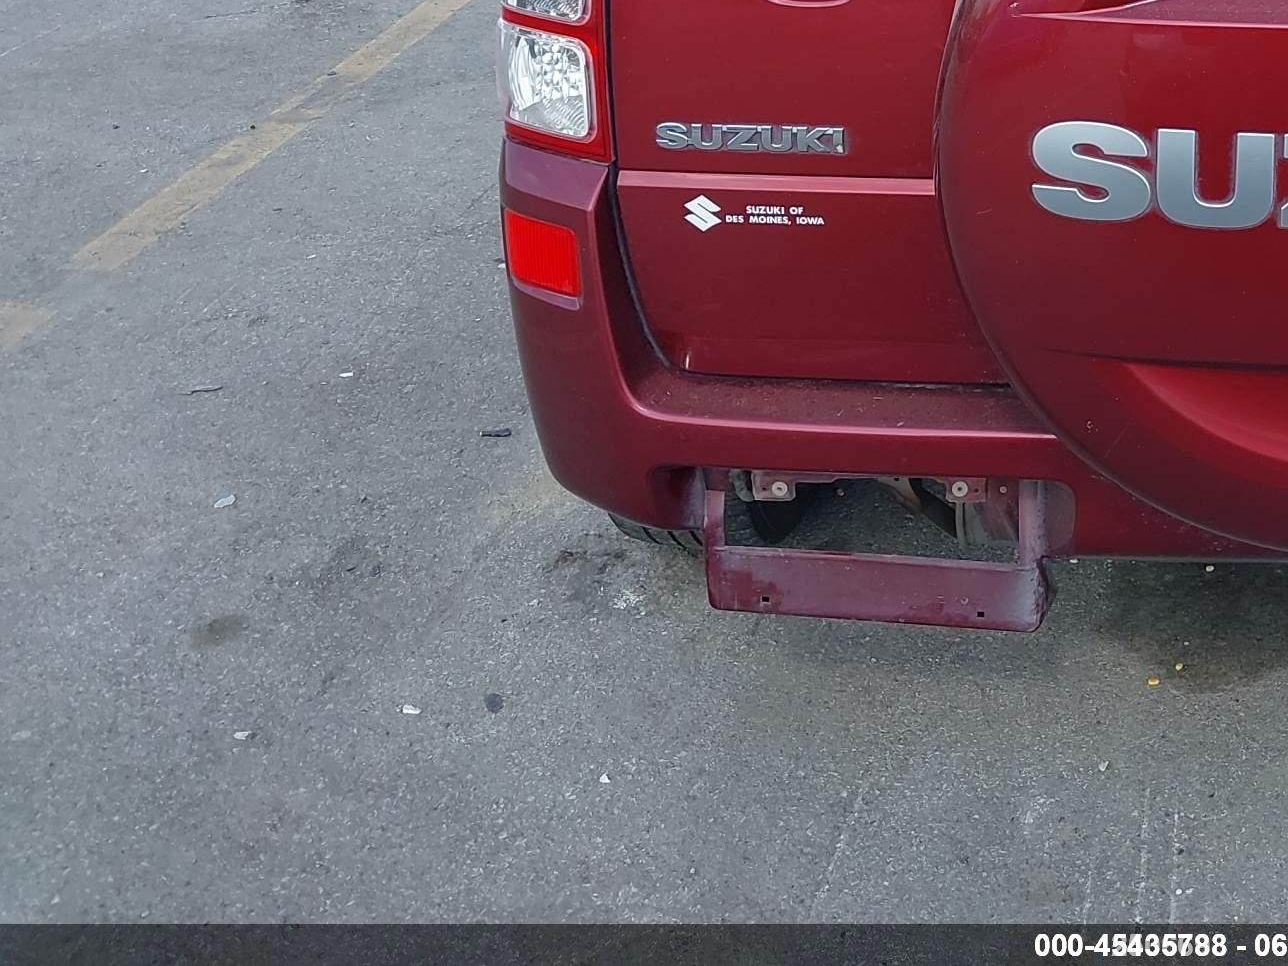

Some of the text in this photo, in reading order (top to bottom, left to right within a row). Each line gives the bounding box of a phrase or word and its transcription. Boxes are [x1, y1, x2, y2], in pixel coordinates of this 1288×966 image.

[655, 121, 847, 155] SUZUKI
[745, 205, 804, 215] SUZUKI OF
[725, 215, 825, 226] DES MOINES, IOWA
